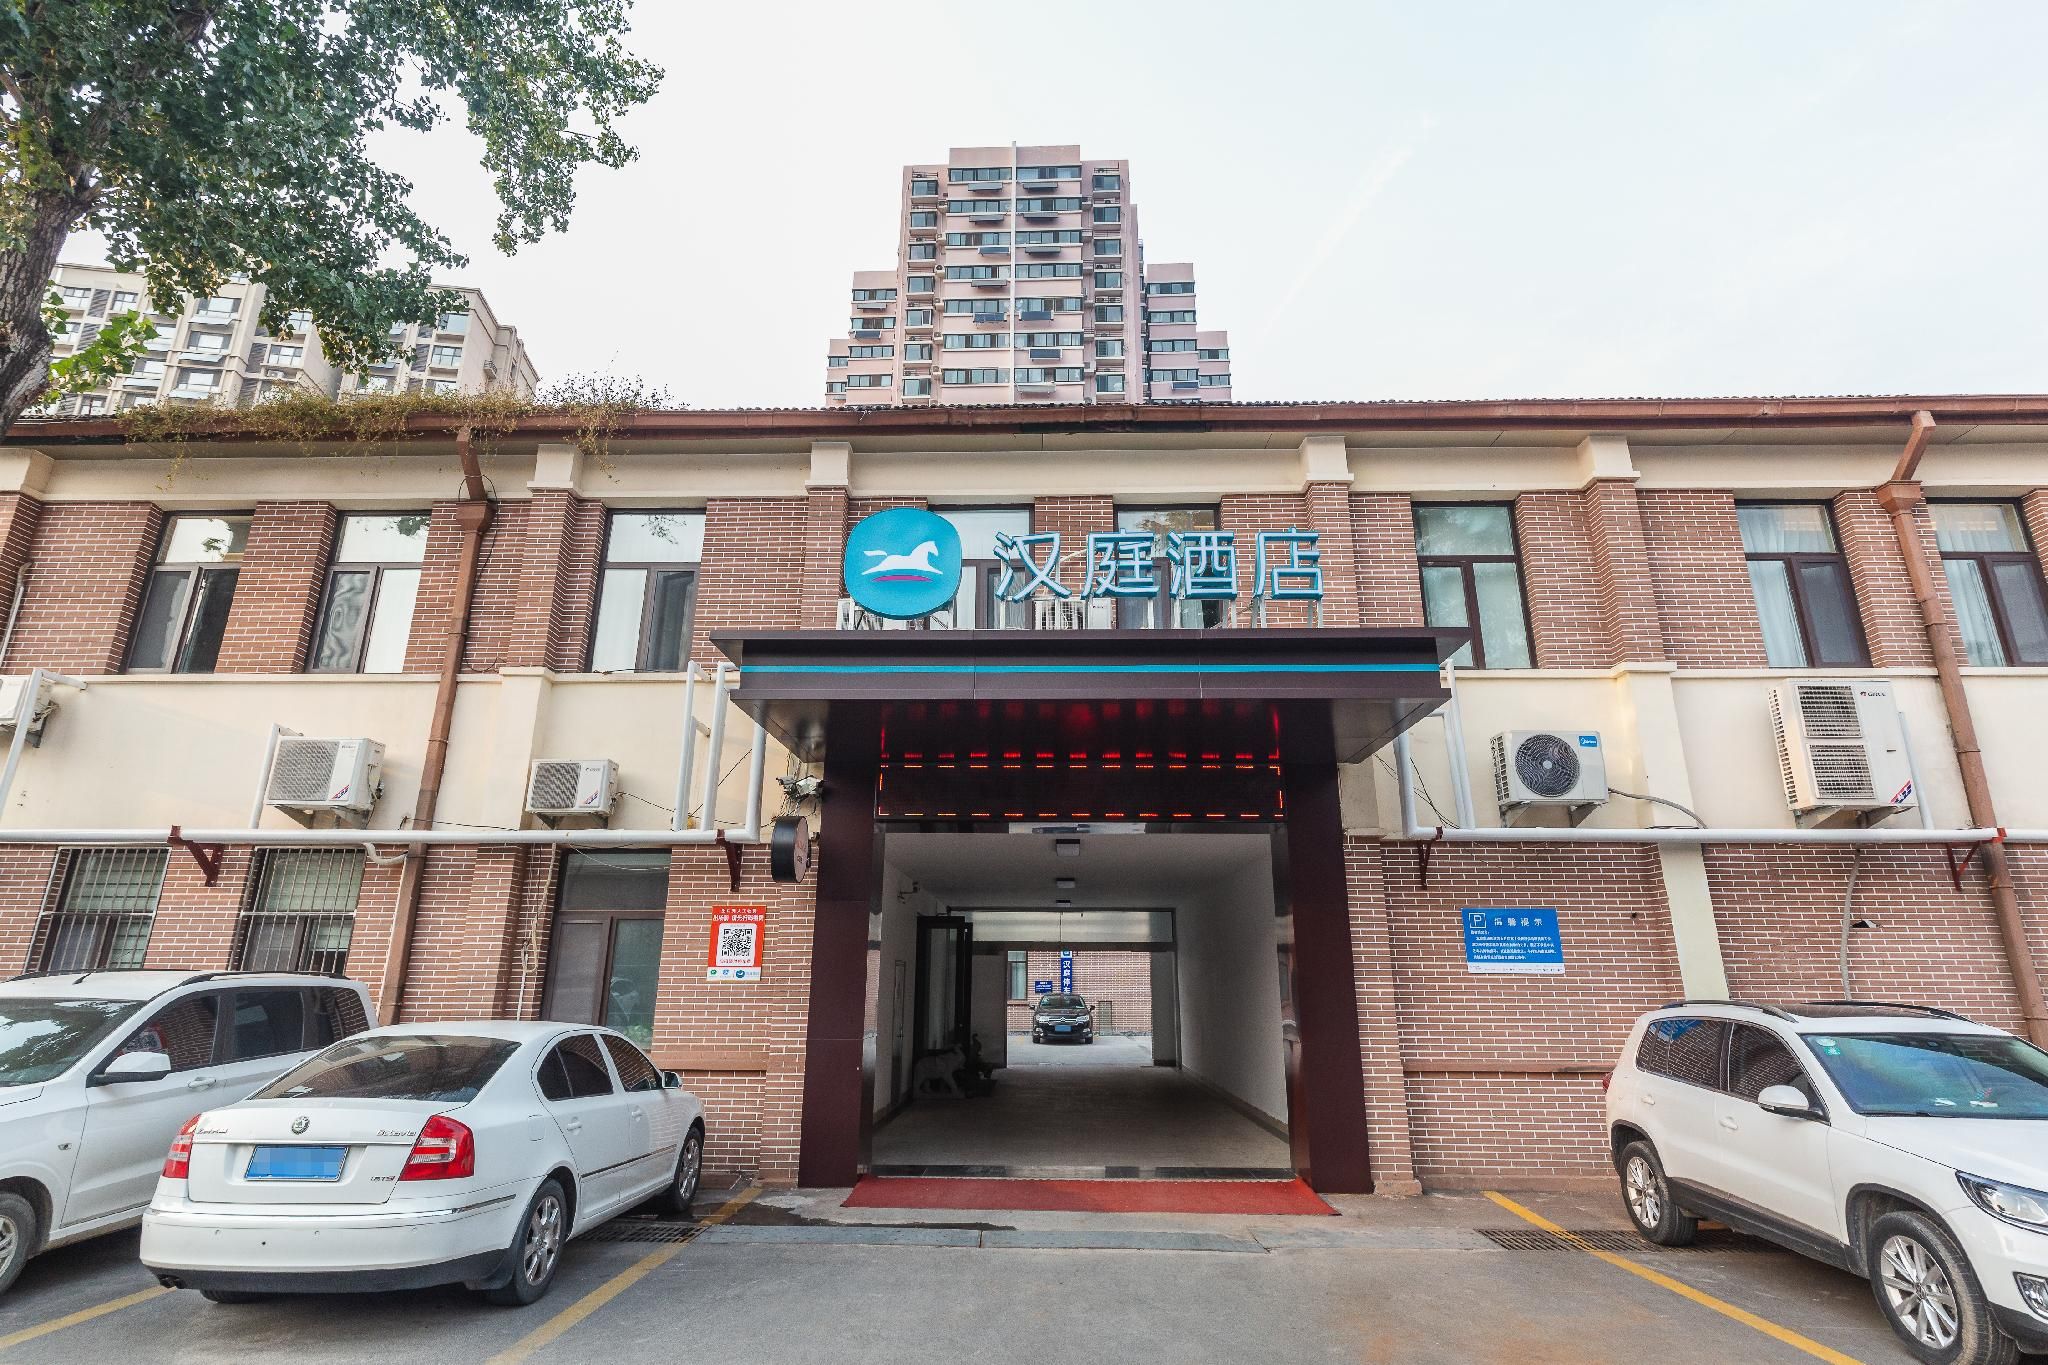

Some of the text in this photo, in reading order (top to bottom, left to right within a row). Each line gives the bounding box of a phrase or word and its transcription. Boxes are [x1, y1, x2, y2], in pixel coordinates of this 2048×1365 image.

[993, 527, 1324, 601] 汉庭酒店
[1494, 917, 1543, 927] 温馨提示
